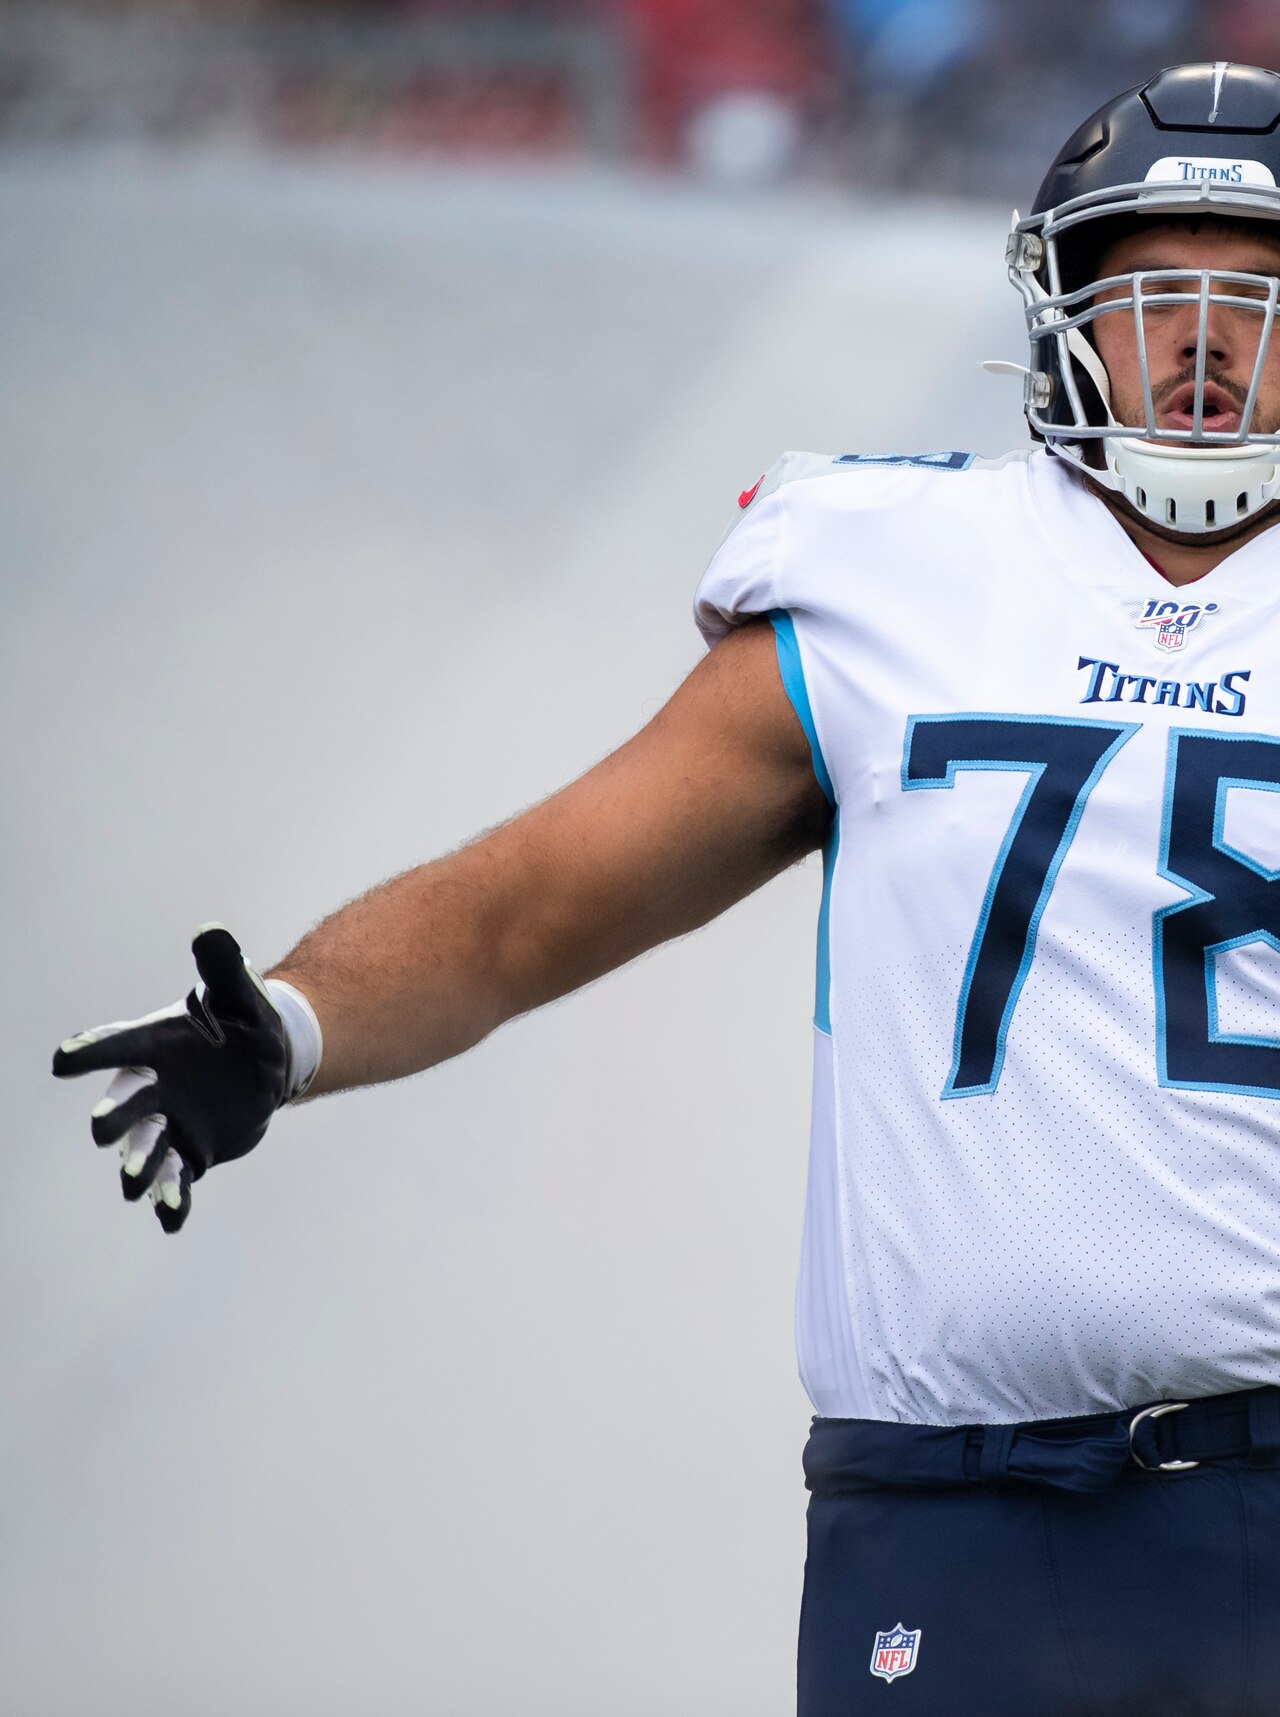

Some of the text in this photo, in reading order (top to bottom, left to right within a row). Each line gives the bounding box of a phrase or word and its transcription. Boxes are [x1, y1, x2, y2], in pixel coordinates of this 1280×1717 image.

[1178, 161, 1242, 183] TITANS
[1160, 632, 1181, 646] NFL
[1077, 655, 1251, 717] TITANS
[877, 1650, 908, 1672] NFL
